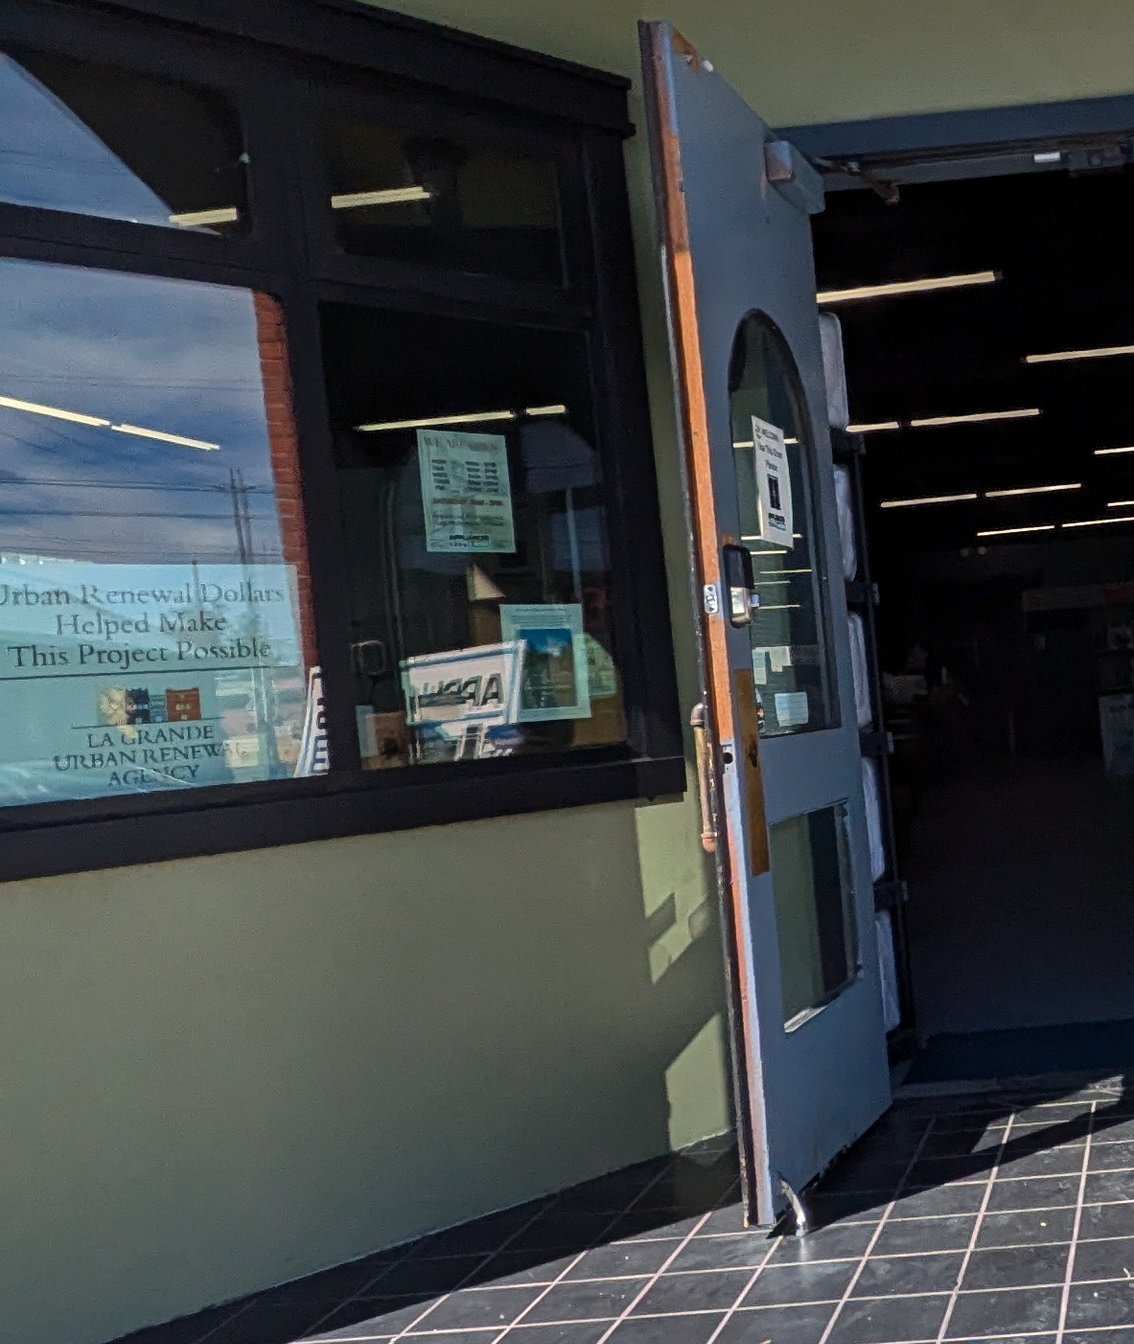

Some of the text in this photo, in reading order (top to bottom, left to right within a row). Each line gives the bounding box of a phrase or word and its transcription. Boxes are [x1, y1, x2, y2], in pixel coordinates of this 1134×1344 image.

[81, 582, 191, 605] Renewal
[201, 580, 285, 603] Dollars
[56, 610, 227, 640] Helped Make
[7, 638, 271, 670] This Project Possible
[87, 725, 215, 749] LA GRANDE
[53, 750, 138, 772] URBAN
